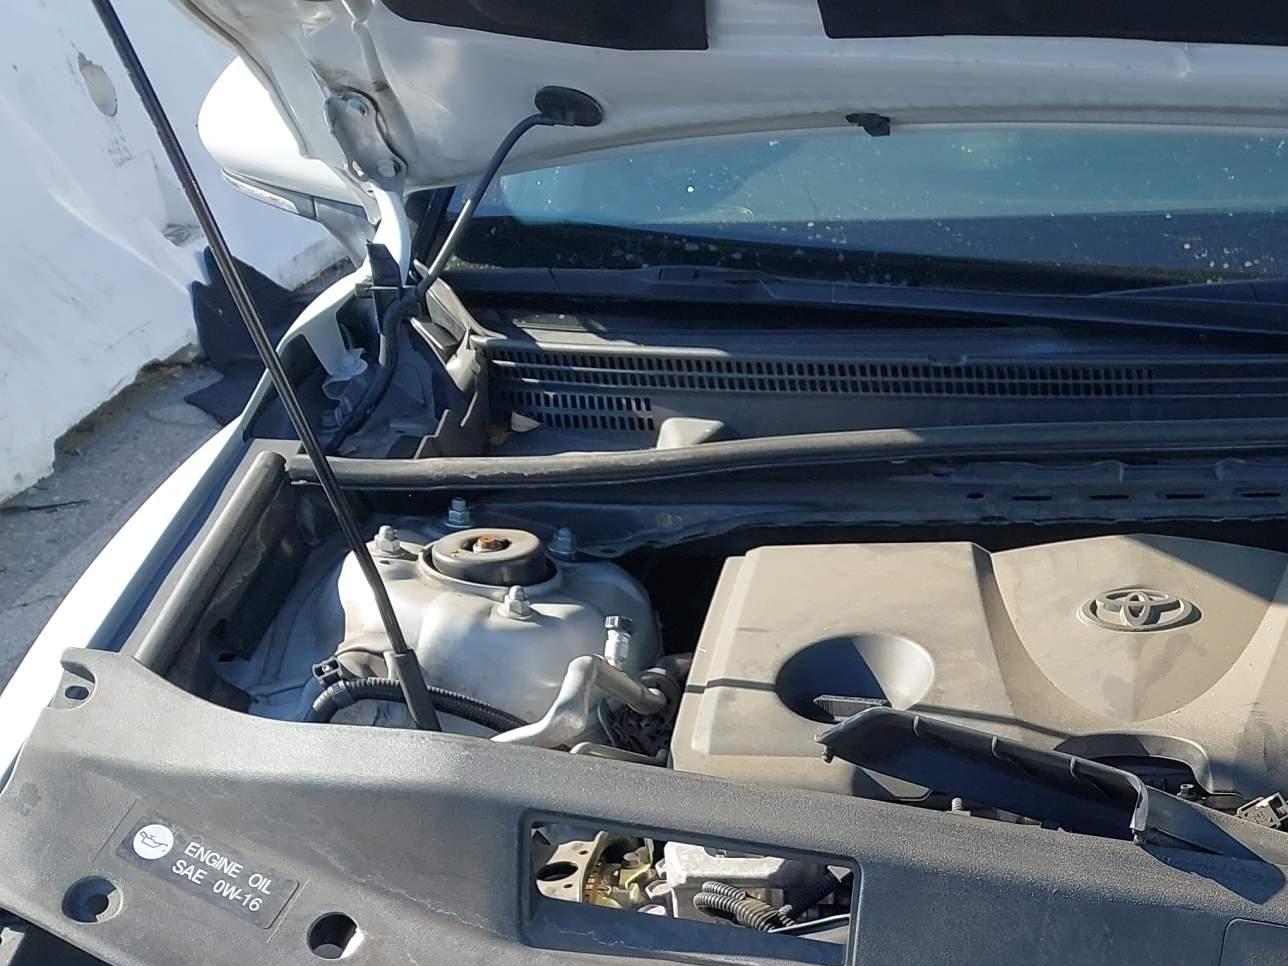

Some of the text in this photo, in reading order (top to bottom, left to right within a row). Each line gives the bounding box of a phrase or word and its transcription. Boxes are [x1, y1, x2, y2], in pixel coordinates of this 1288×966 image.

[172, 859, 263, 912] SAE 0W-16
[183, 841, 273, 895] ENGINE OIL
